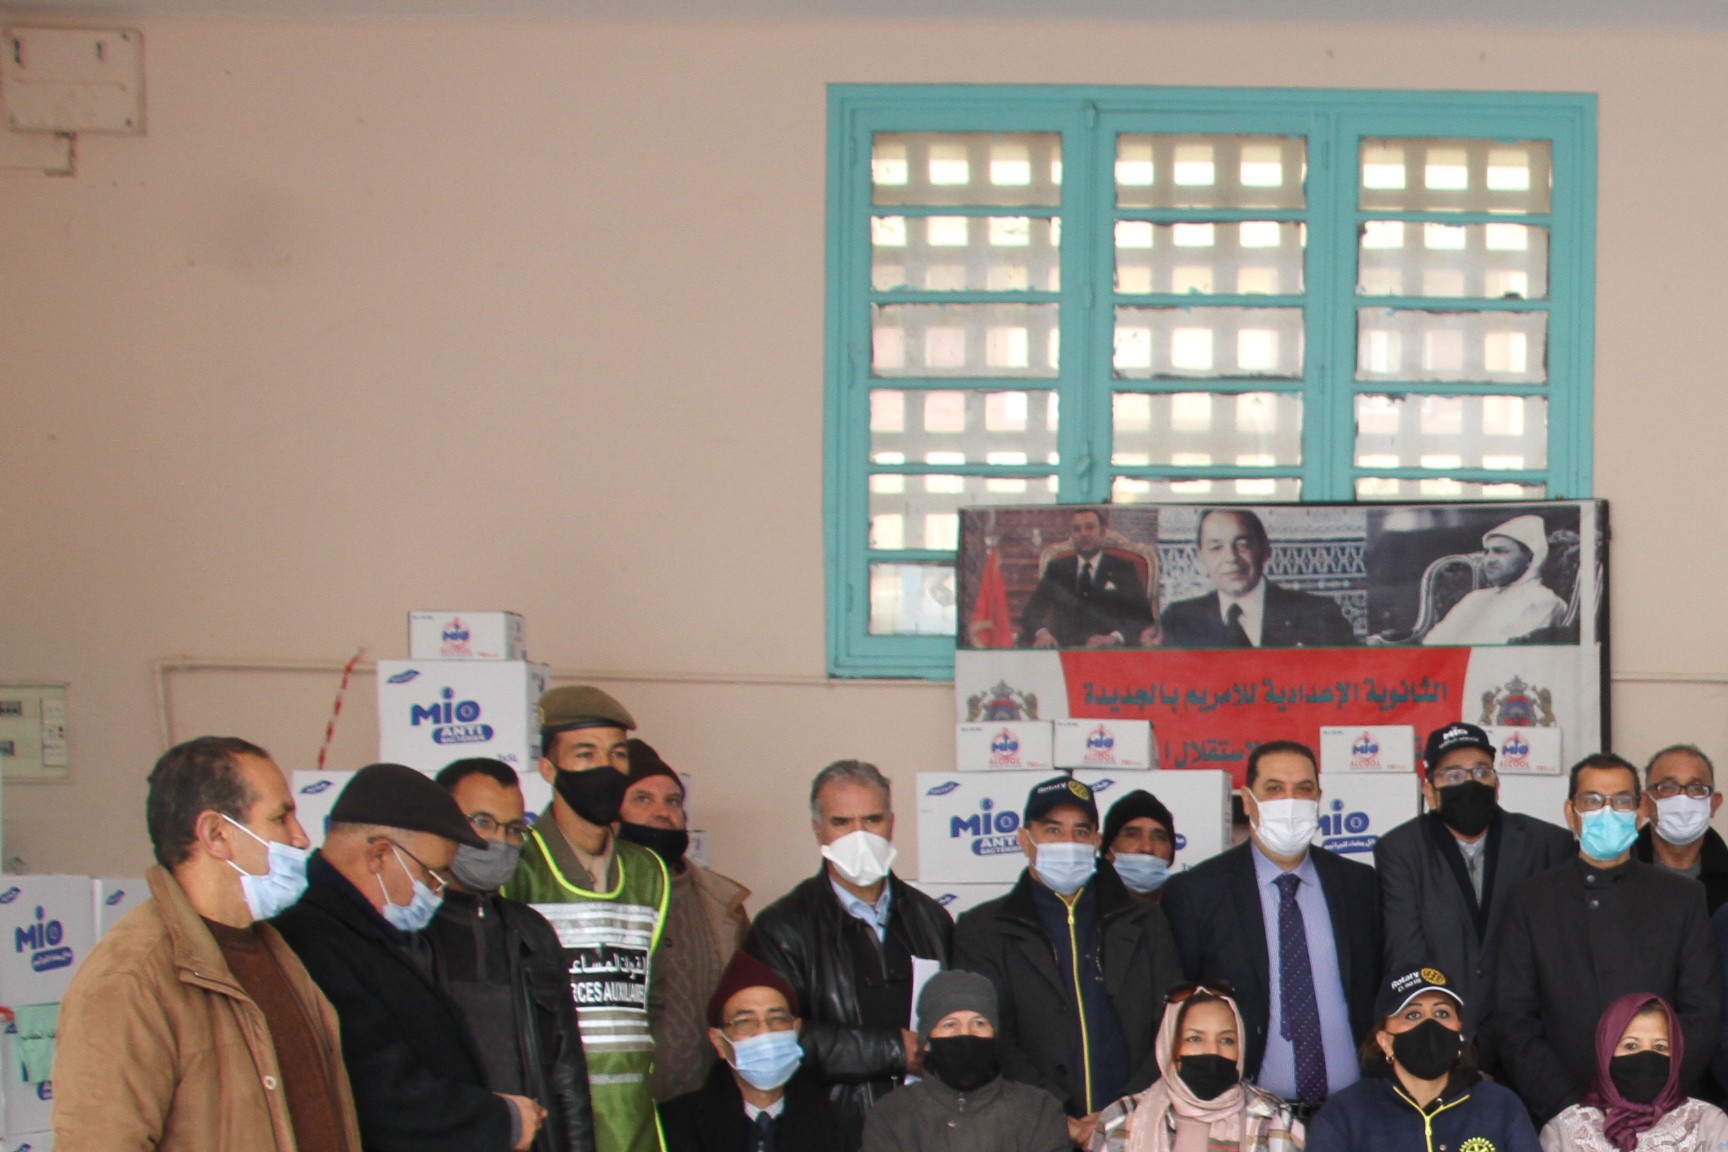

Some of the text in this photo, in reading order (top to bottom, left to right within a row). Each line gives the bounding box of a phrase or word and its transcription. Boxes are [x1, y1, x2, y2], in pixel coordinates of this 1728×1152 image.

[1365, 676, 1449, 711] الثانوية
[441, 725, 482, 737] ANTI
[981, 836, 1018, 848] ANT
[1391, 971, 1419, 989] Rotary
